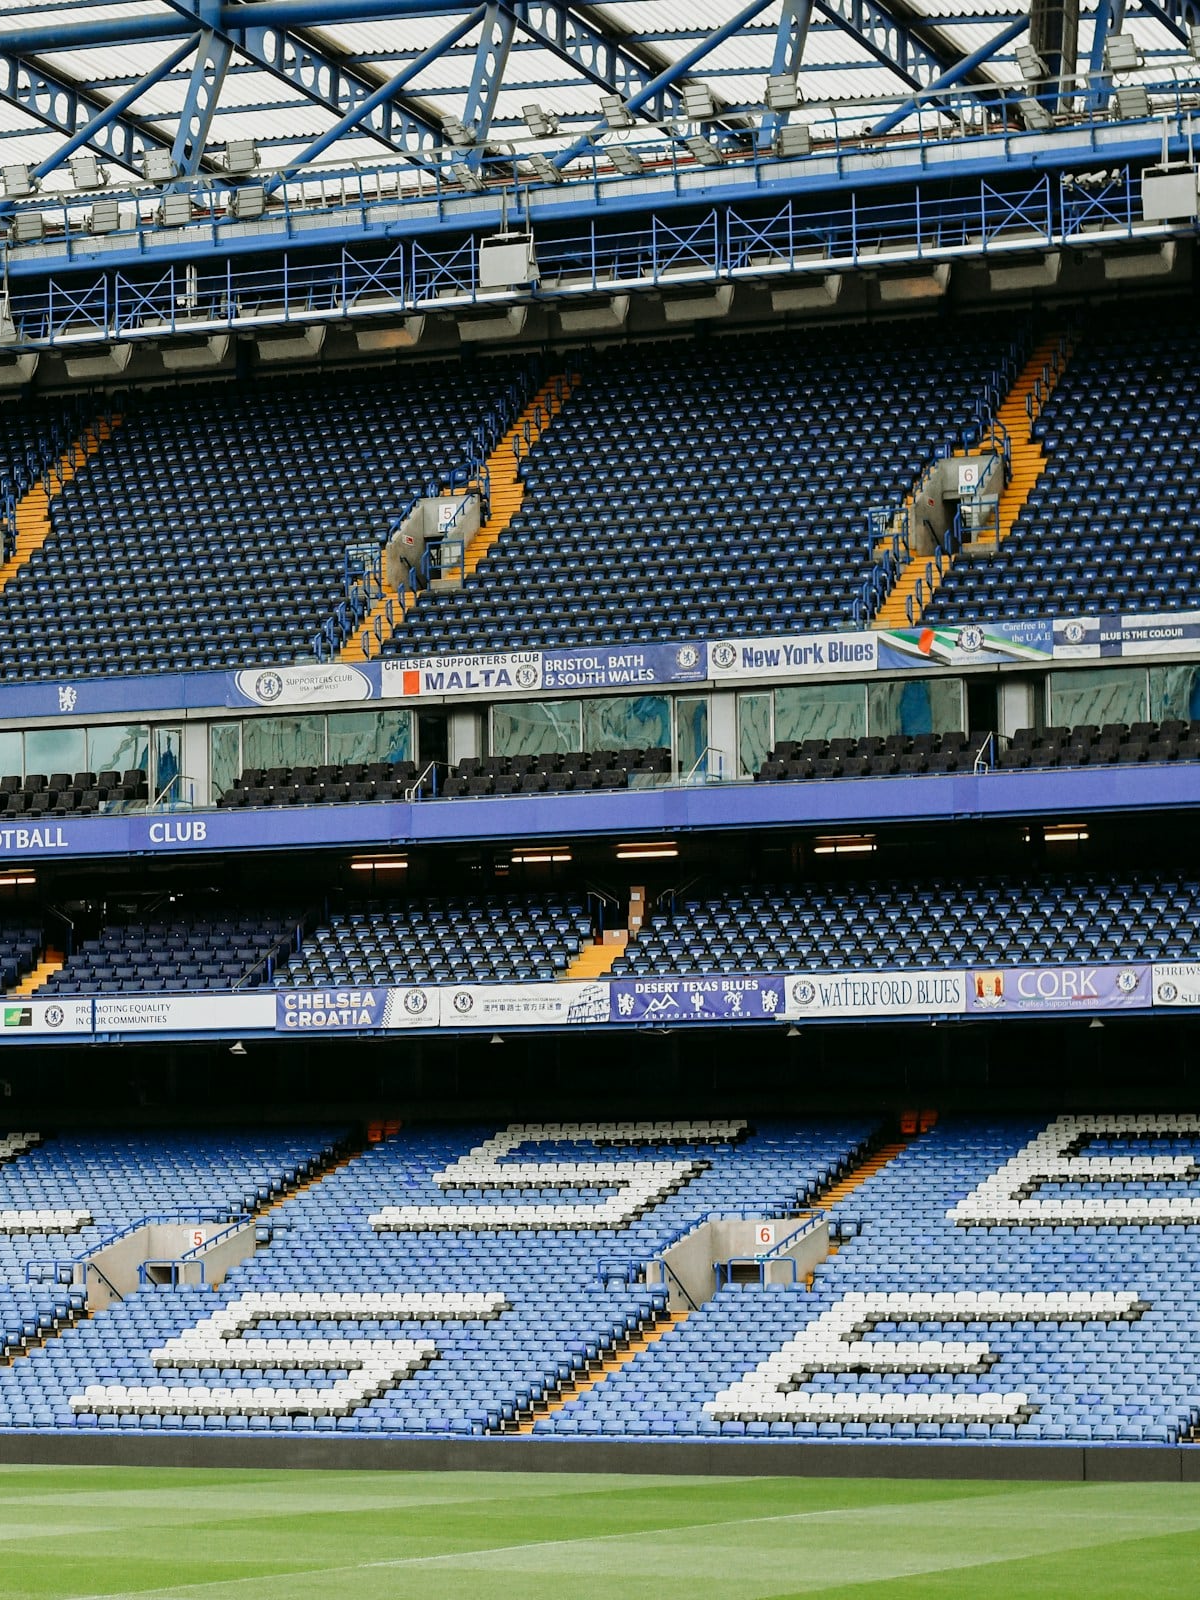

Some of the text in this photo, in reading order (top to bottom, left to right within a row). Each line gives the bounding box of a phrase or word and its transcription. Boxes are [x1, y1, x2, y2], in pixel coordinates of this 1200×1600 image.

[964, 468, 973, 482] 6
[443, 507, 452, 520] 5
[1100, 628, 1184, 641] BLUE IS THE COLOUR
[384, 653, 540, 671] CHELSEA SUPPORTERS CLUB
[545, 654, 644, 672] BRISTOL, BATH
[742, 641, 874, 669] New York Blues
[285, 674, 353, 686] SUPPORTERS CLUB
[425, 668, 512, 691] MALTA
[545, 674, 555, 687] &
[557, 671, 606, 686] SOUTH
[608, 668, 655, 683] WALES
[149, 821, 207, 843] CLUB
[635, 980, 759, 994] DESERT TEXAS BLUES
[818, 978, 960, 1007] WATERFORD BLUES
[1017, 969, 1098, 998] CORK
[130, 1003, 172, 1013] EQUALITY
[284, 991, 377, 1010] CHELSEA
[75, 1017, 84, 1025] IN
[108, 1015, 168, 1024] COMMUNITIES
[285, 1009, 372, 1027] CROATIA
[193, 1231, 203, 1246] 5
[760, 1227, 770, 1243] 6
